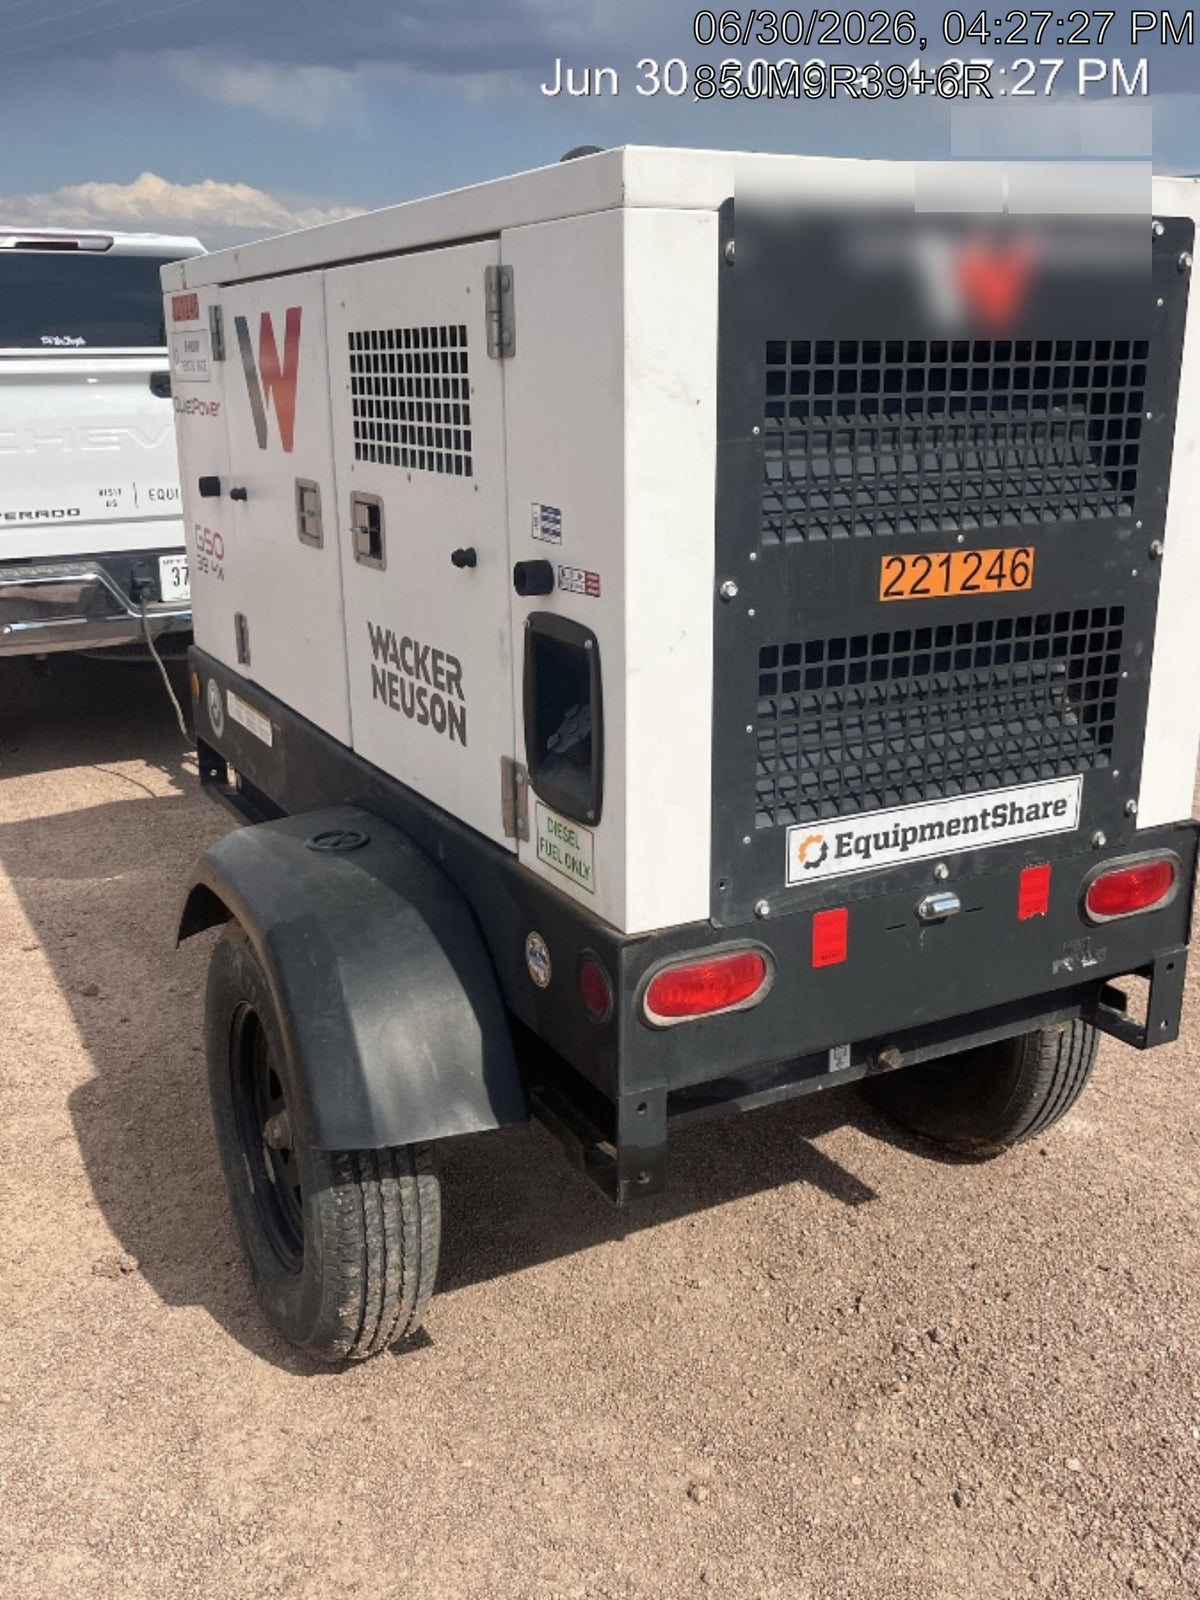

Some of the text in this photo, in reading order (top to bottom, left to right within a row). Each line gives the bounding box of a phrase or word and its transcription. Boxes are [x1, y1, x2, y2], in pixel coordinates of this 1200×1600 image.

[0, 508, 80, 520] ERADO
[883, 548, 1032, 598] 221246
[367, 620, 465, 701] WACKER
[371, 662, 467, 748] NEUSON
[547, 817, 580, 851] DIESEL
[833, 797, 1068, 860] EquipmentShare
[540, 836, 591, 880] FUEL ONLY
